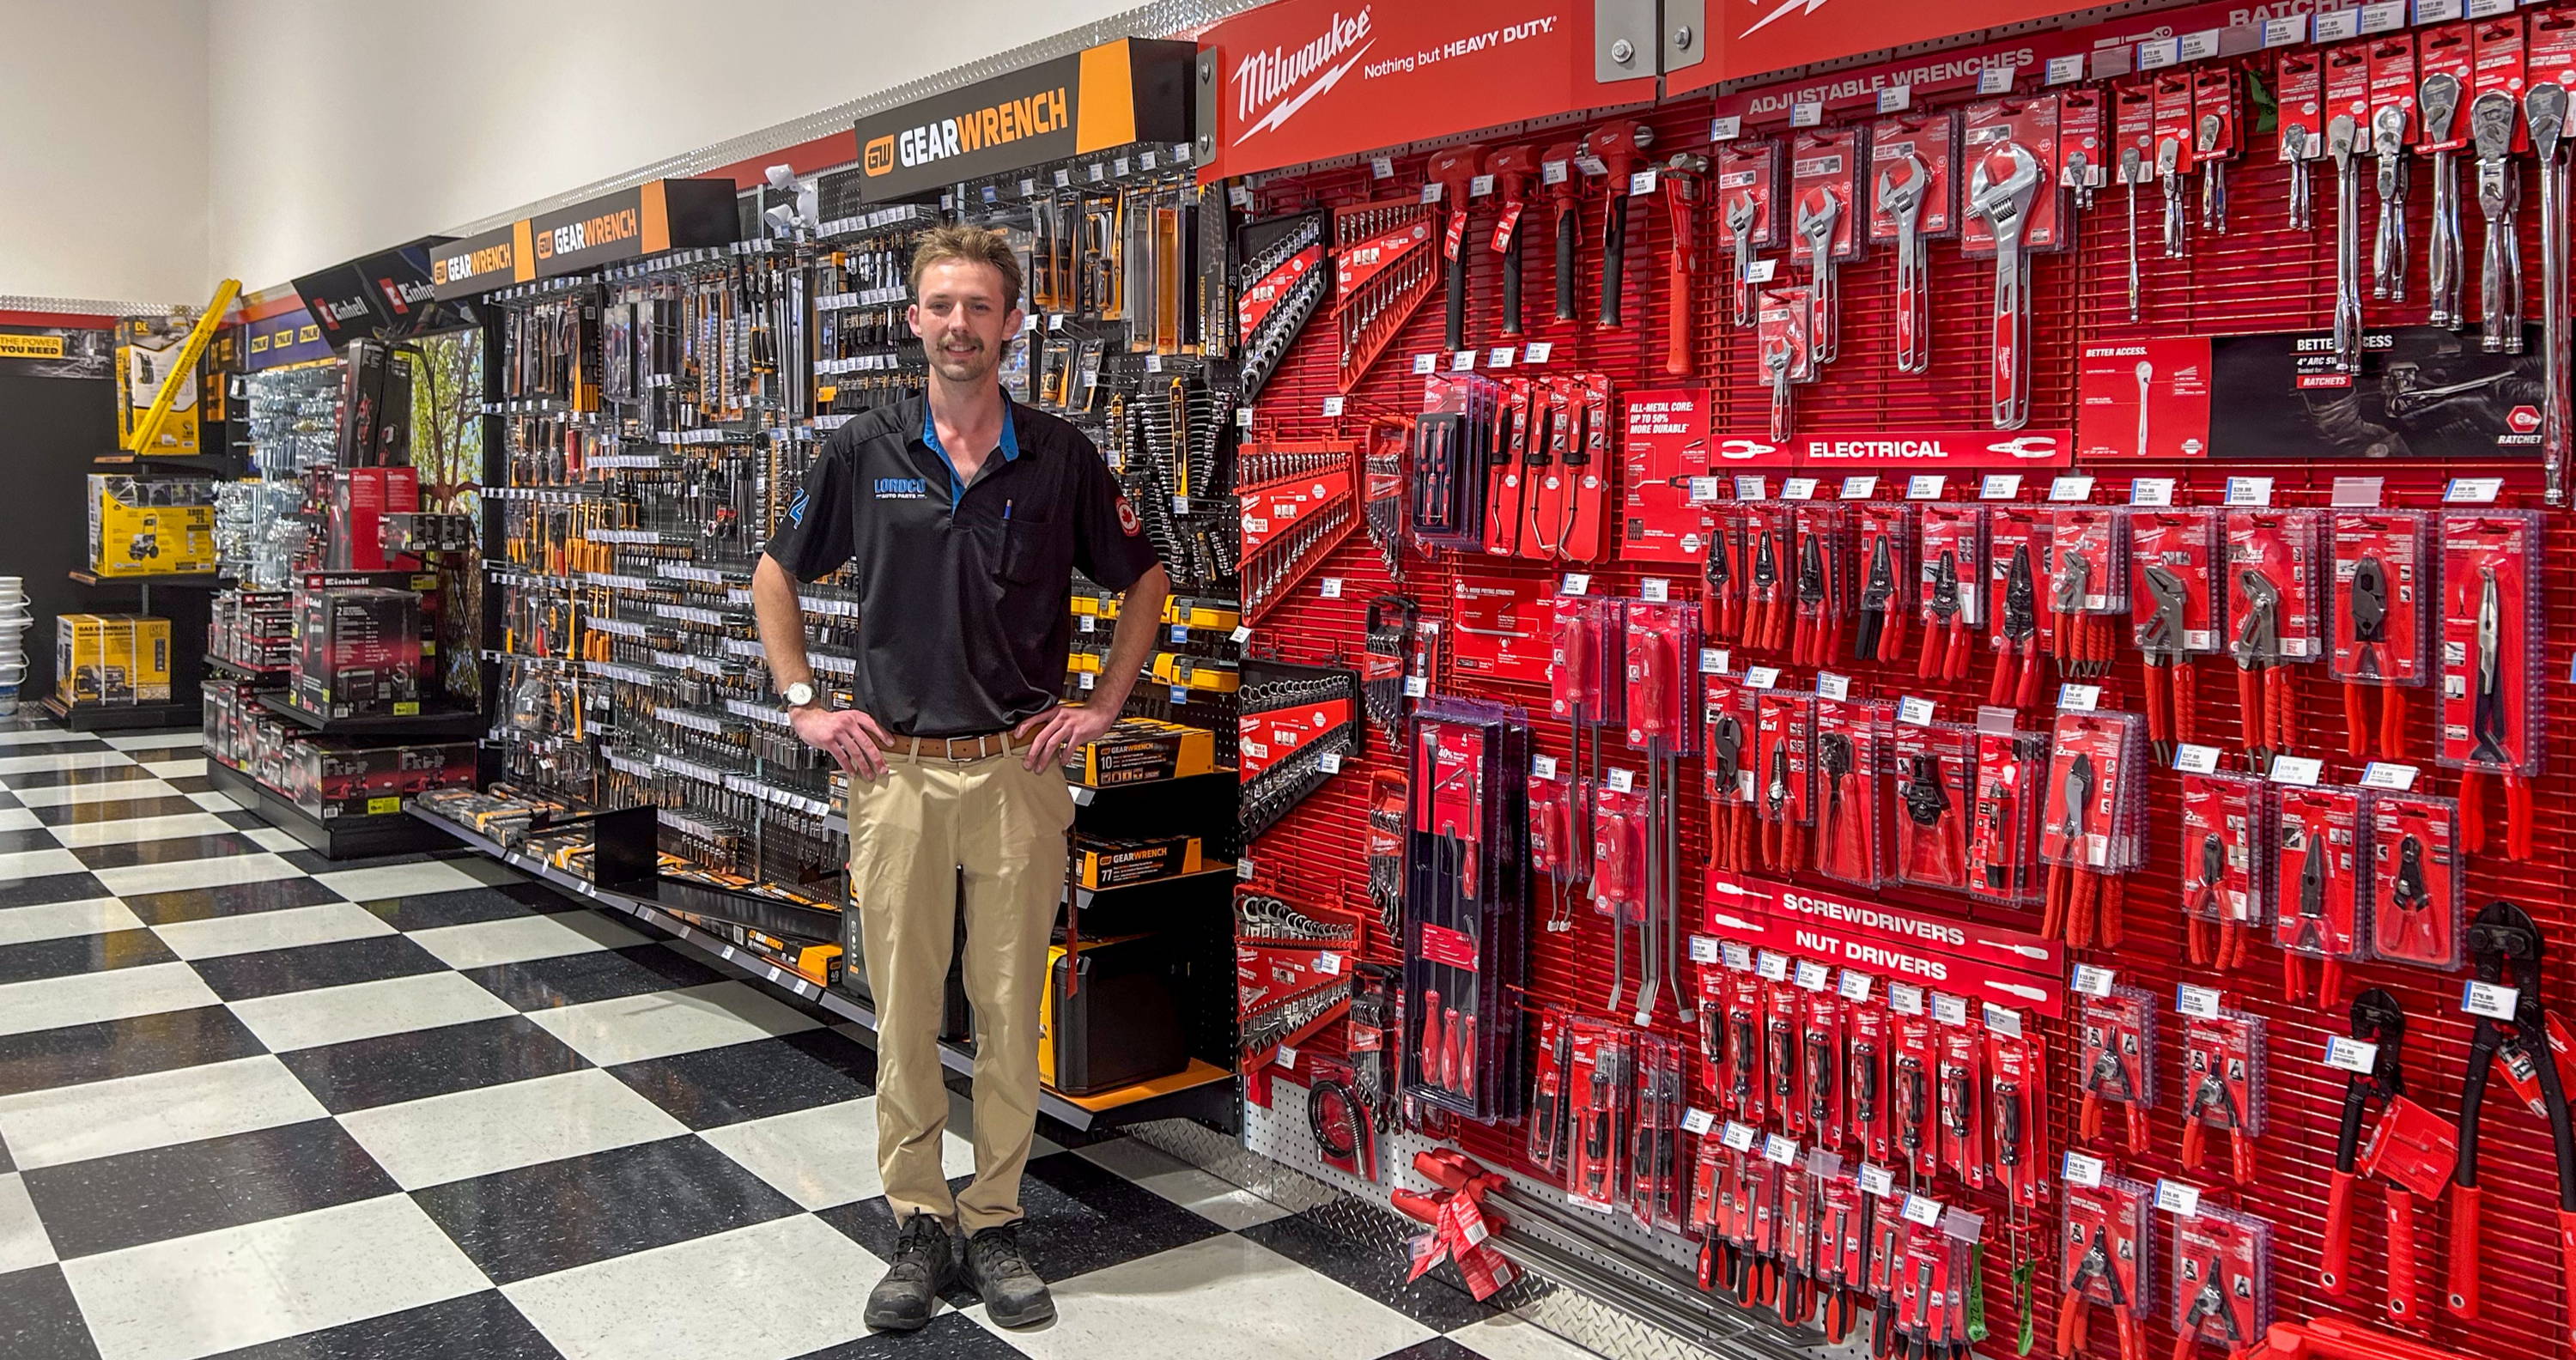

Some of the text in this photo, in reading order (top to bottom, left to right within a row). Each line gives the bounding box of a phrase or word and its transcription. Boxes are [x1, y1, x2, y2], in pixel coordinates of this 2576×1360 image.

[1364, 56, 1415, 80] Nothing
[1418, 49, 1441, 67] but
[1443, 31, 1498, 59] HEAVY
[1231, 8, 1371, 121] Milwaukee
[1749, 48, 2034, 115] ADJUSTABLE WRENCHES
[899, 88, 1068, 167] GEARWRENCH
[2433, 141, 2458, 150] DRIVE
[555, 209, 638, 254] GEARWRENCH
[448, 244, 512, 282] GEARWRENCH
[398, 280, 434, 304] Einhe
[329, 296, 368, 321] Einhell
[1, 337, 59, 346] THE POWER
[2297, 335, 2393, 351] BETTE CESS
[1, 345, 58, 355] YOU NEED
[2086, 348, 2114, 358] BETTER
[2303, 376, 2347, 386] RATCHETS
[1630, 402, 1693, 412] ALL-METAL CORE:
[1630, 414, 1668, 423] UP TO 50%
[1630, 424, 1652, 434] MORE
[1809, 441, 1947, 458] ELECTRICAL
[874, 478, 927, 494] LORDCO
[325, 576, 370, 586] Einhell
[1111, 743, 1153, 754] GEARWRENCH
[1101, 756, 1112, 770] 10
[1113, 847, 1168, 864] GEARWRENCH
[1102, 869, 1113, 882] 77
[1783, 894, 1965, 945] SCREWDRIVERS
[1796, 930, 1947, 981] NUT DRIVERS
